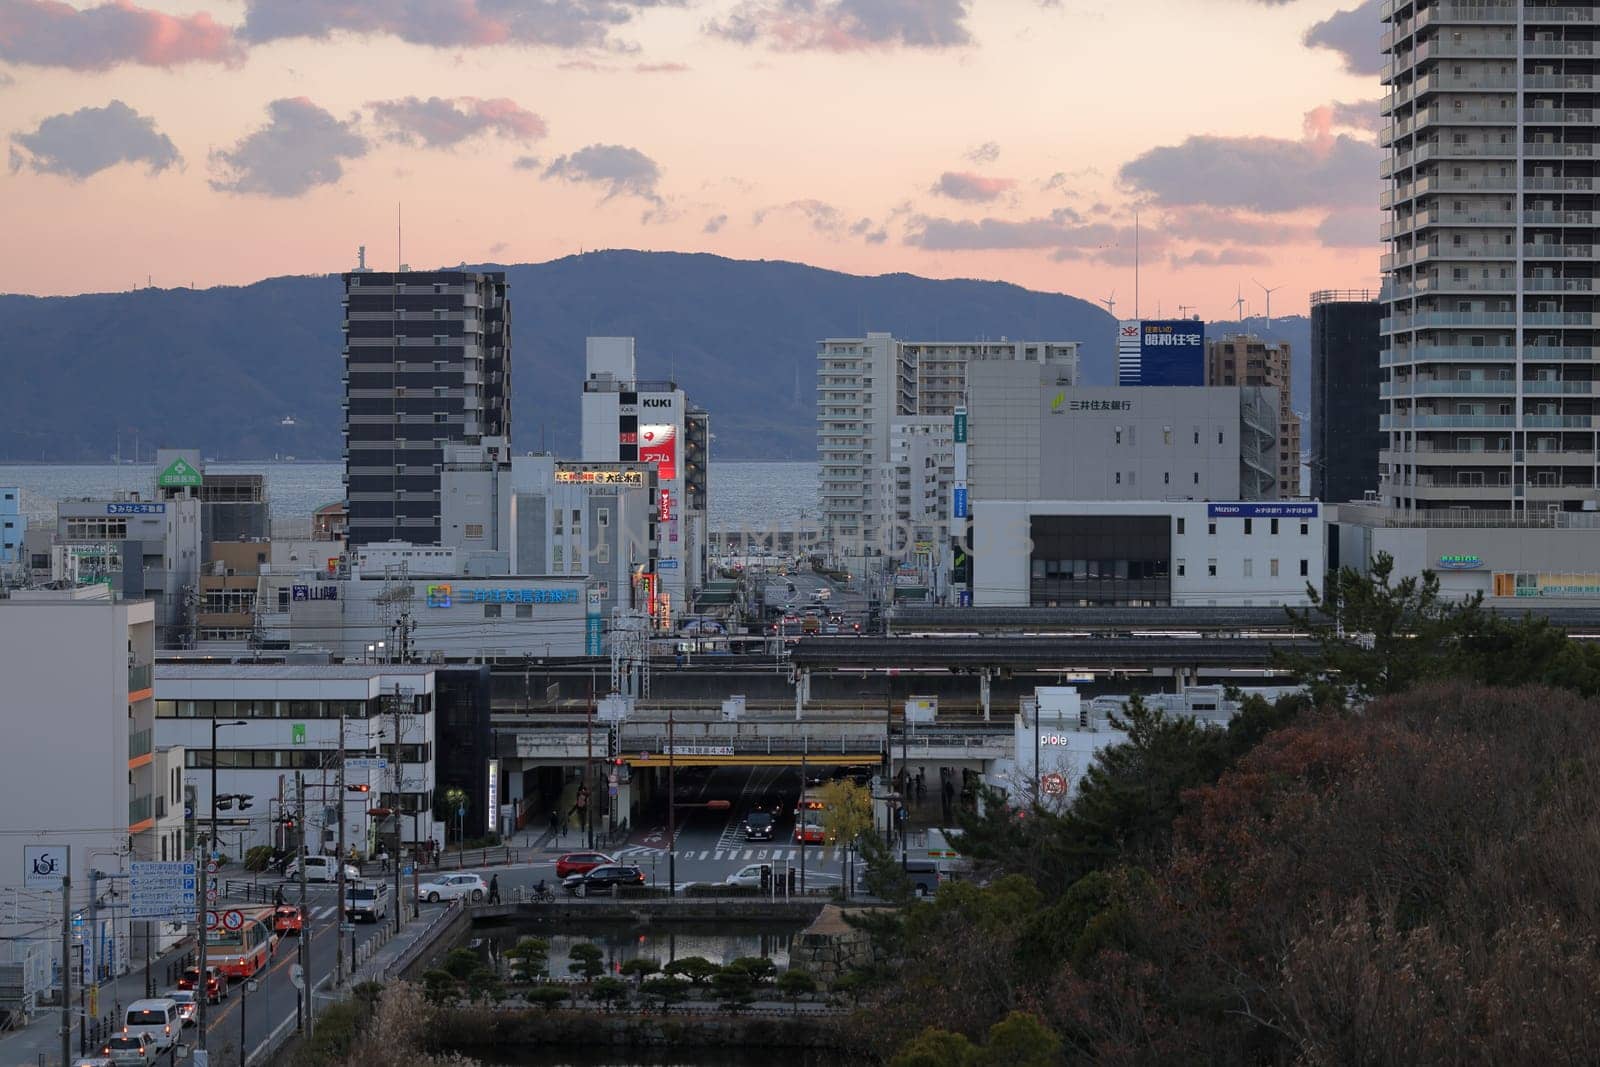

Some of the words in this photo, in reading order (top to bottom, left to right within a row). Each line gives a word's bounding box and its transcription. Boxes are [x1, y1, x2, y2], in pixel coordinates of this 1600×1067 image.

[1144, 333, 1201, 346] 昭和住宅
[643, 399, 672, 408] KUKI
[1069, 400, 1131, 411] 三井住友銀行
[643, 453, 670, 462] アコム
[605, 473, 642, 483] 大庄水産
[1254, 507, 1283, 515] みずほ銀行
[459, 588, 578, 603] 三井住友信託銀行
[1040, 732, 1068, 746] piole
